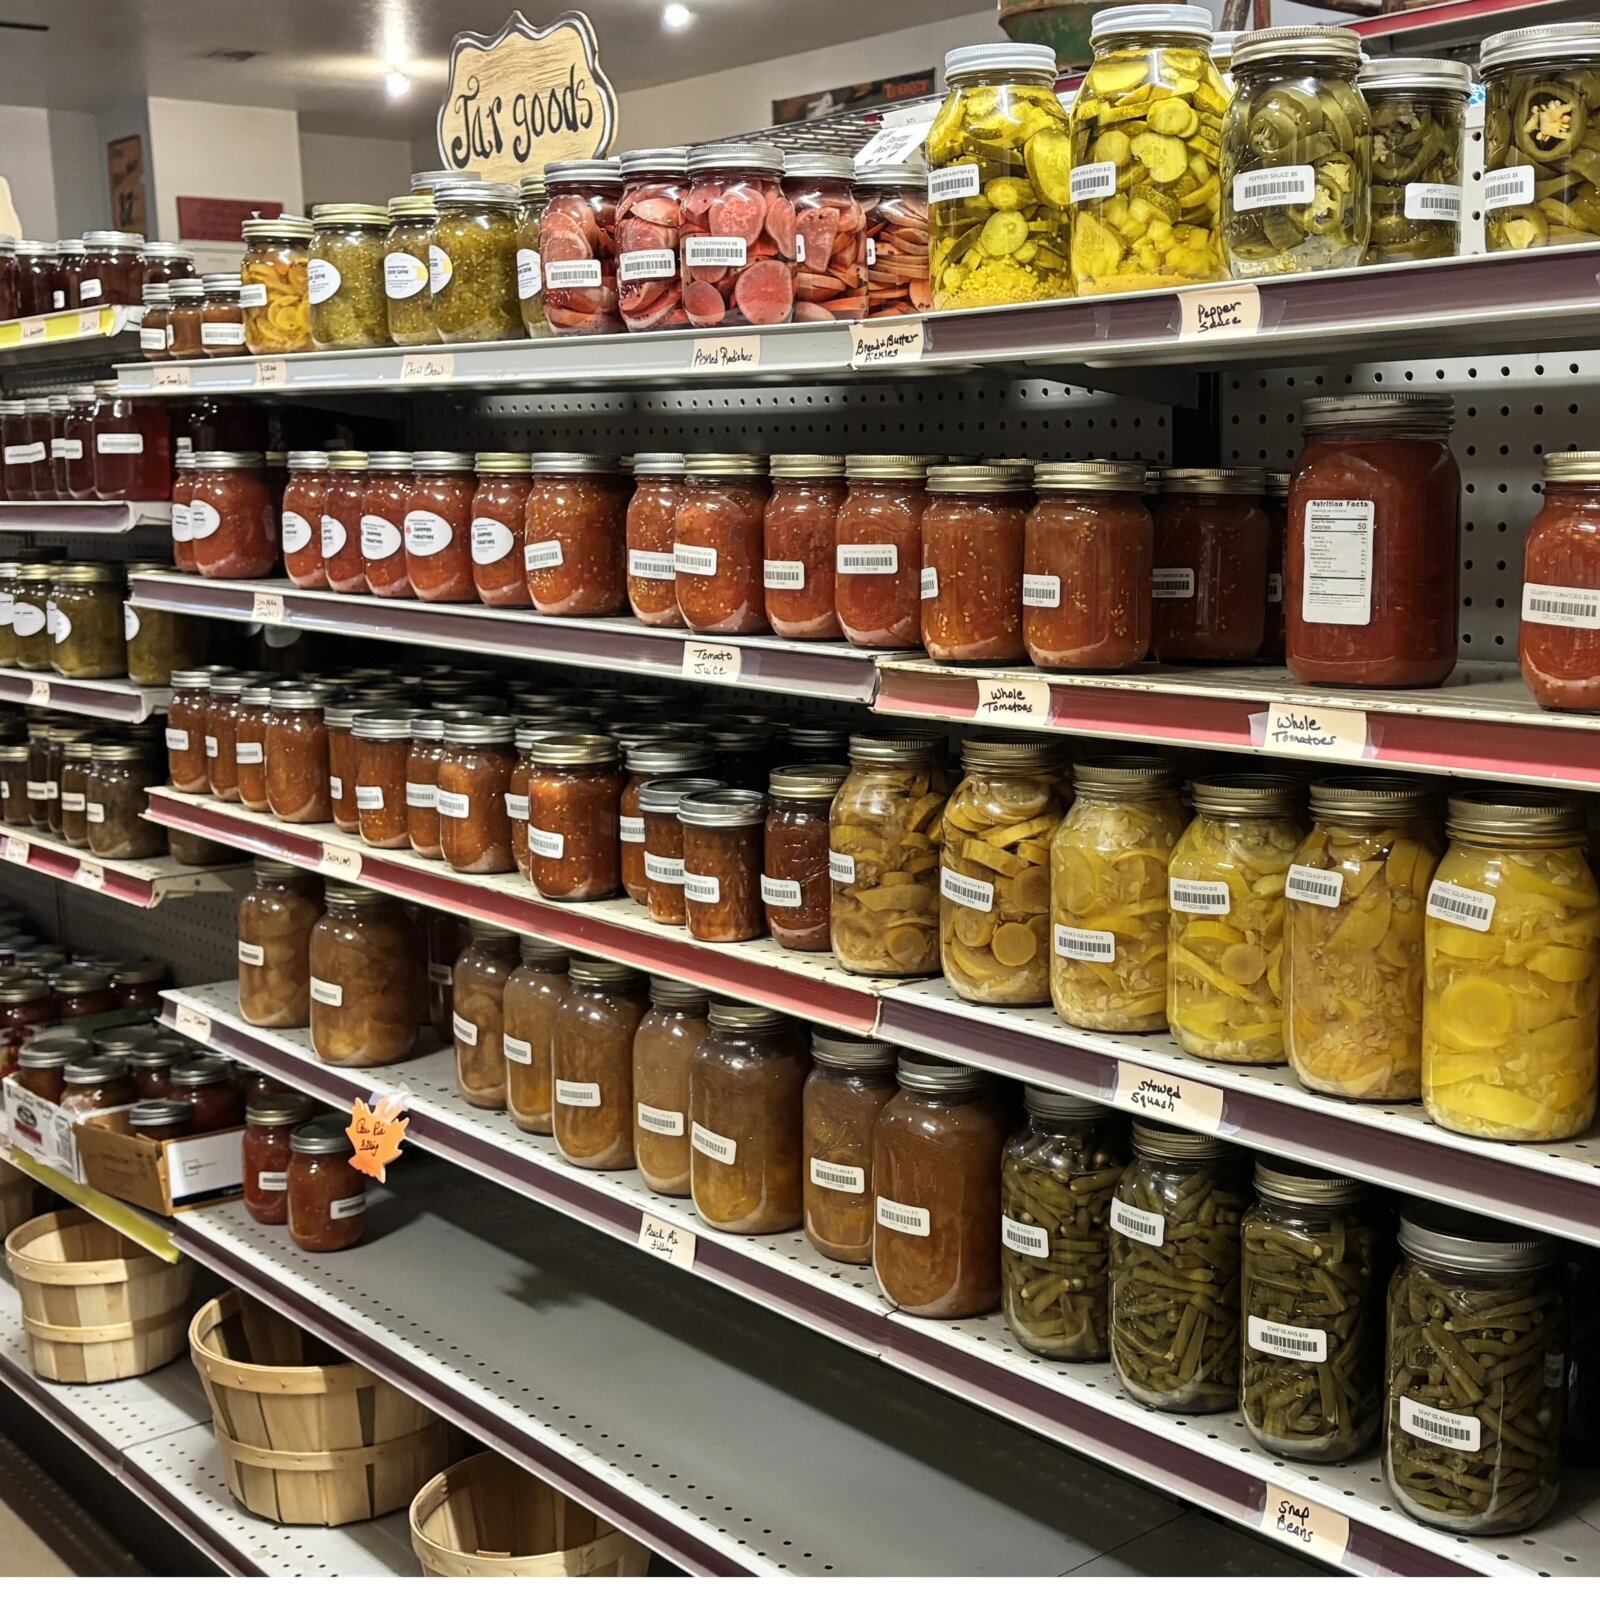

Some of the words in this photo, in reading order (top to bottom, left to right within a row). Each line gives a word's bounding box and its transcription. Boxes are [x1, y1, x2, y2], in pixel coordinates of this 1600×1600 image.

[451, 75, 503, 169] Jar
[512, 63, 593, 163] goods
[1198, 302, 1242, 323] Pepper
[1197, 317, 1242, 333] Sauce
[864, 349, 899, 363] Pickles
[1357, 522, 1367, 530] 50
[694, 648, 733, 661] Tomato
[694, 663, 728, 675] Juice
[990, 687, 1026, 701] Whole
[982, 701, 1032, 713] Tomatoes
[1276, 713, 1321, 731] Whole
[1272, 731, 1336, 746] Tomatoes
[1281, 1328, 1299, 1337] BEANS
[1418, 1408, 1432, 1417] SNAP
[1432, 1412, 1450, 1423] BEANS
[1451, 1418, 1462, 1426] $10
[1278, 1500, 1310, 1526] Snap
[1276, 1514, 1314, 1543] Beans
